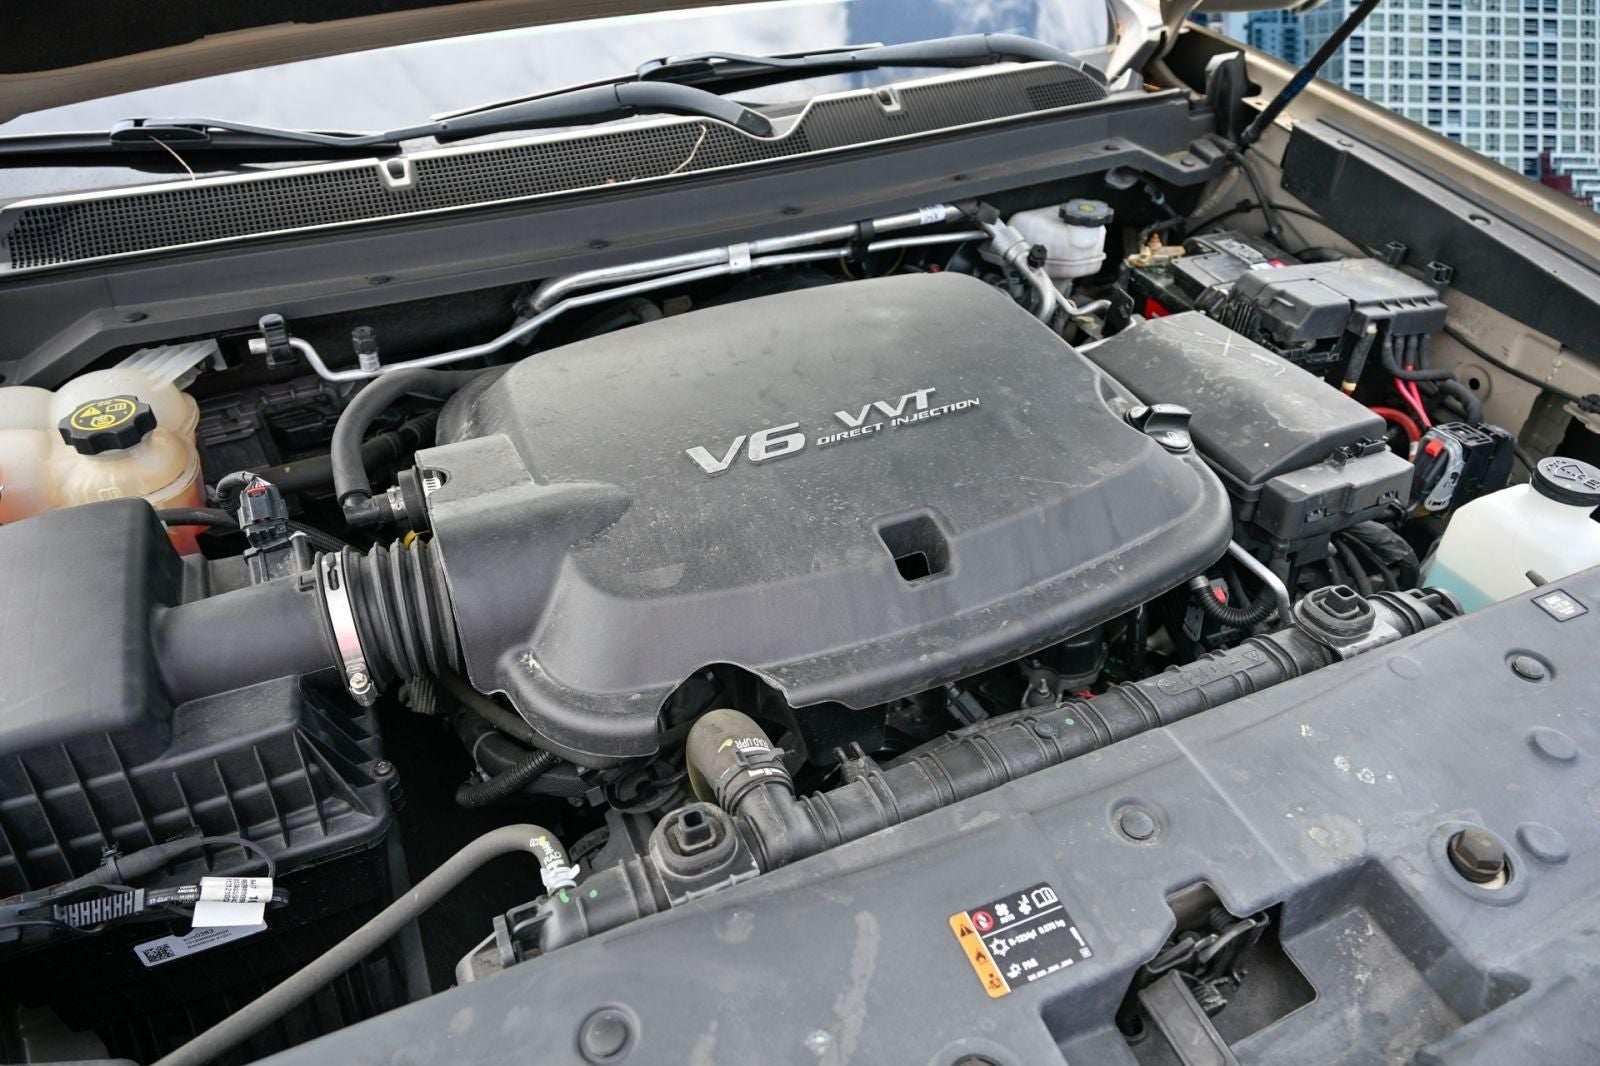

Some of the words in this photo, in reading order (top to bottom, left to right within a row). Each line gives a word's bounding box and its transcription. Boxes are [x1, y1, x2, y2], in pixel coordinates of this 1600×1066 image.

[816, 422, 884, 447] DIRECT
[891, 397, 980, 427] INJECTION
[834, 387, 936, 427] VVT
[685, 422, 806, 474] V6
[734, 737, 754, 749] UPR
